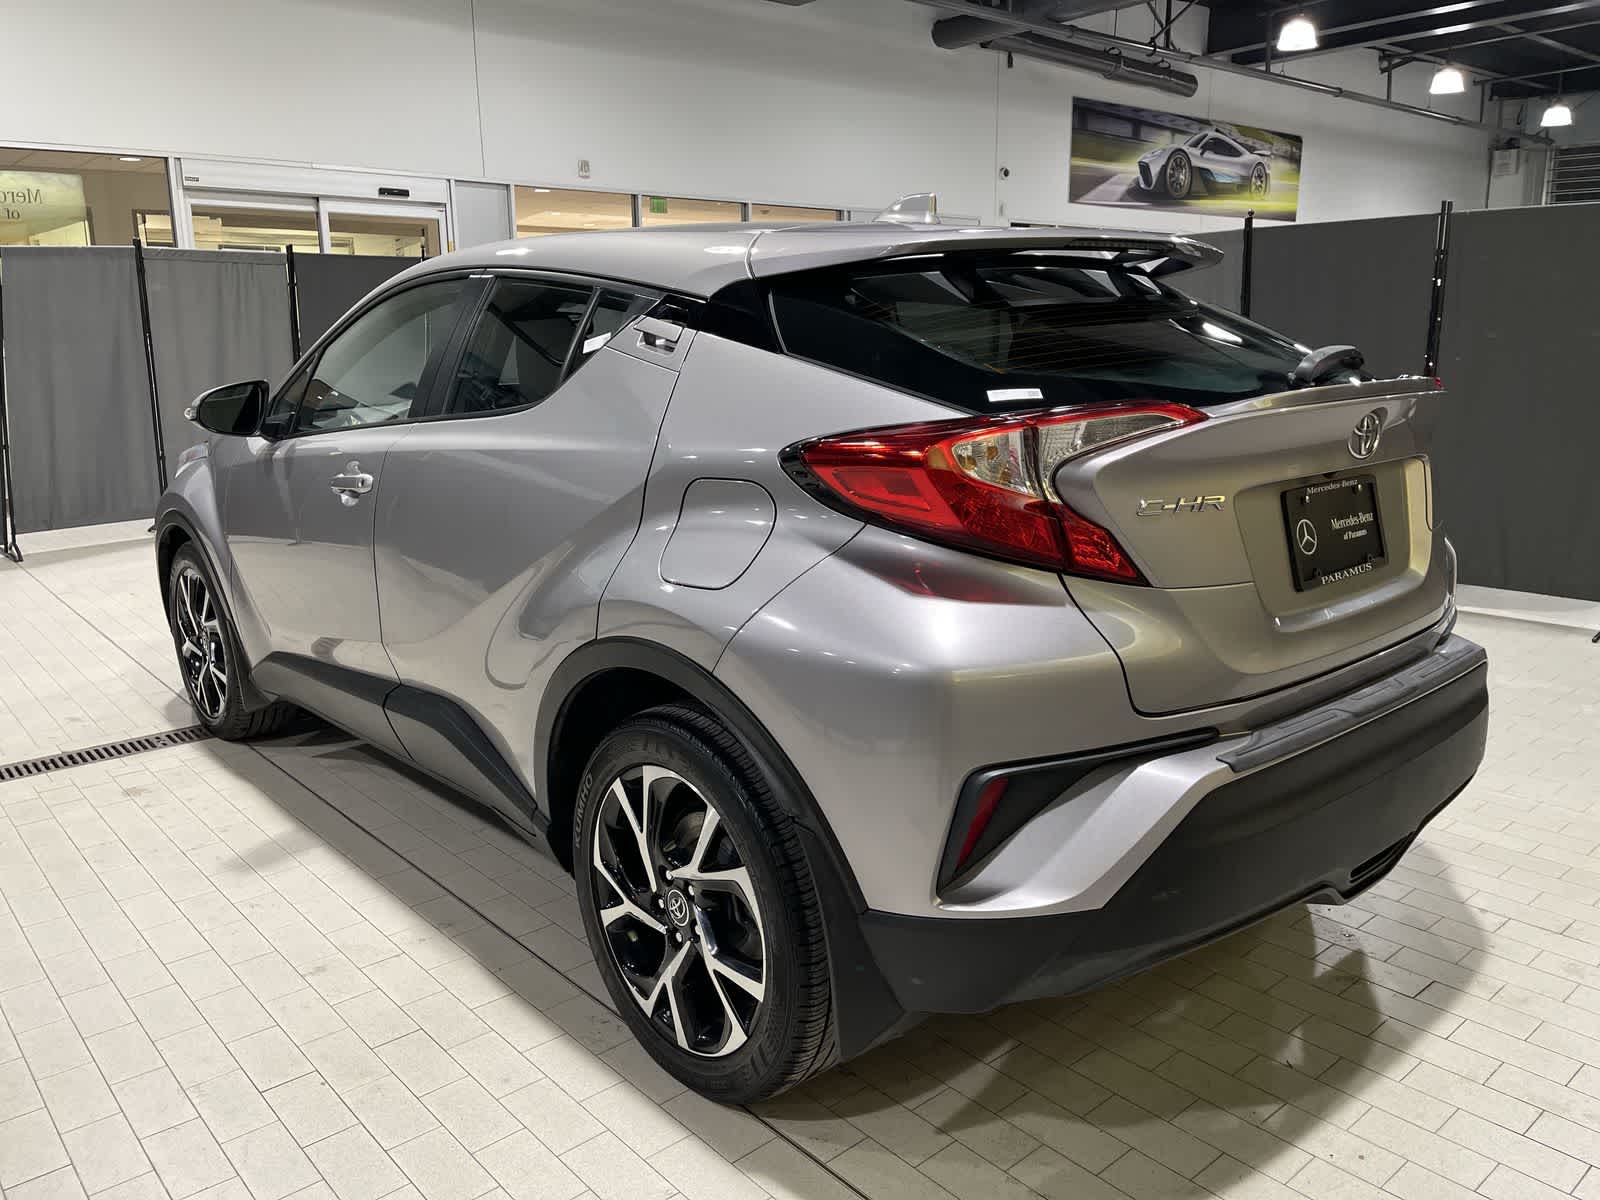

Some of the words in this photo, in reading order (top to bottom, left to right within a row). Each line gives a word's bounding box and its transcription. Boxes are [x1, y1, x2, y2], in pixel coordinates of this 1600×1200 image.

[1136, 495, 1225, 516] C-HR
[1331, 512, 1374, 529] Mercedes-Benz
[1320, 562, 1373, 585] PARAMUS
[575, 772, 593, 848] KUMHO
